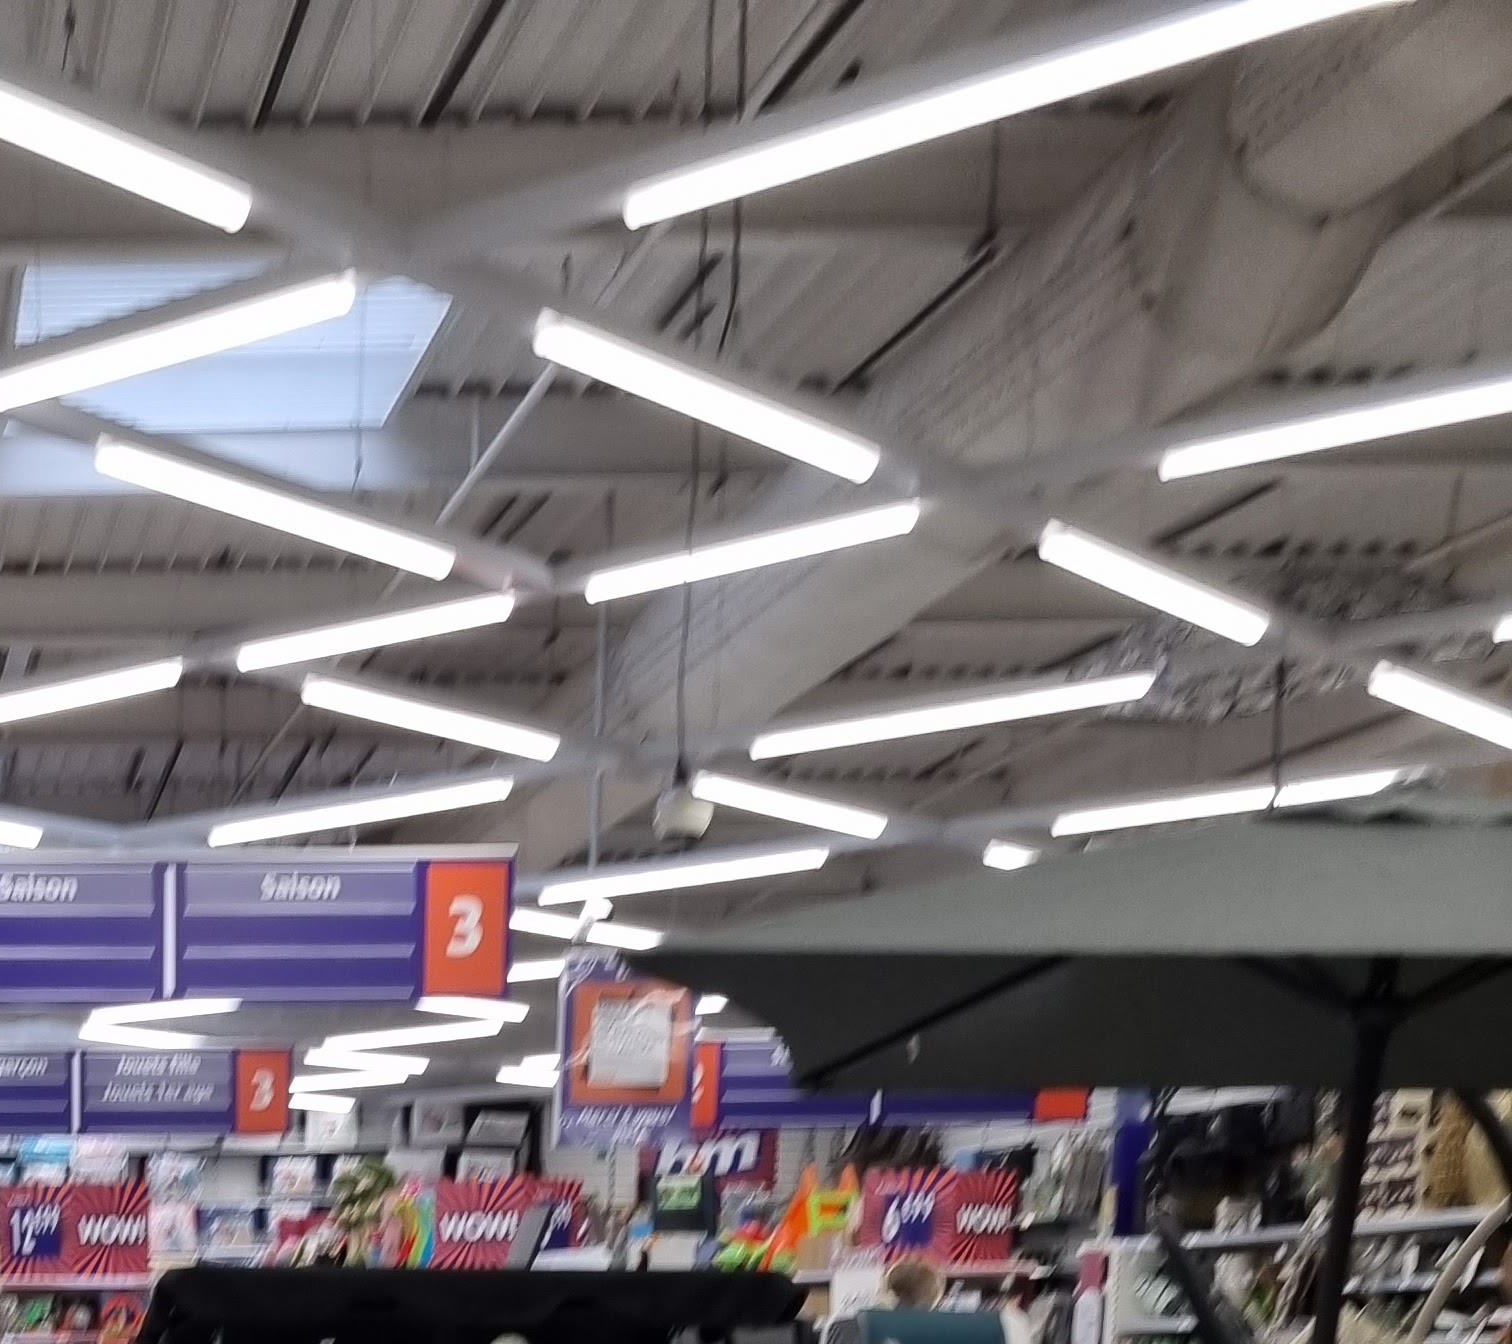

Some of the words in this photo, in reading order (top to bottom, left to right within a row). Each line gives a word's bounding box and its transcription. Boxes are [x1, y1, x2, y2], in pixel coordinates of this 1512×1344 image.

[260, 870, 341, 901] Saison
[445, 892, 484, 958] 3
[249, 1066, 275, 1112] 3
[77, 1213, 148, 1247] WOW!
[438, 1209, 521, 1243] WOW!
